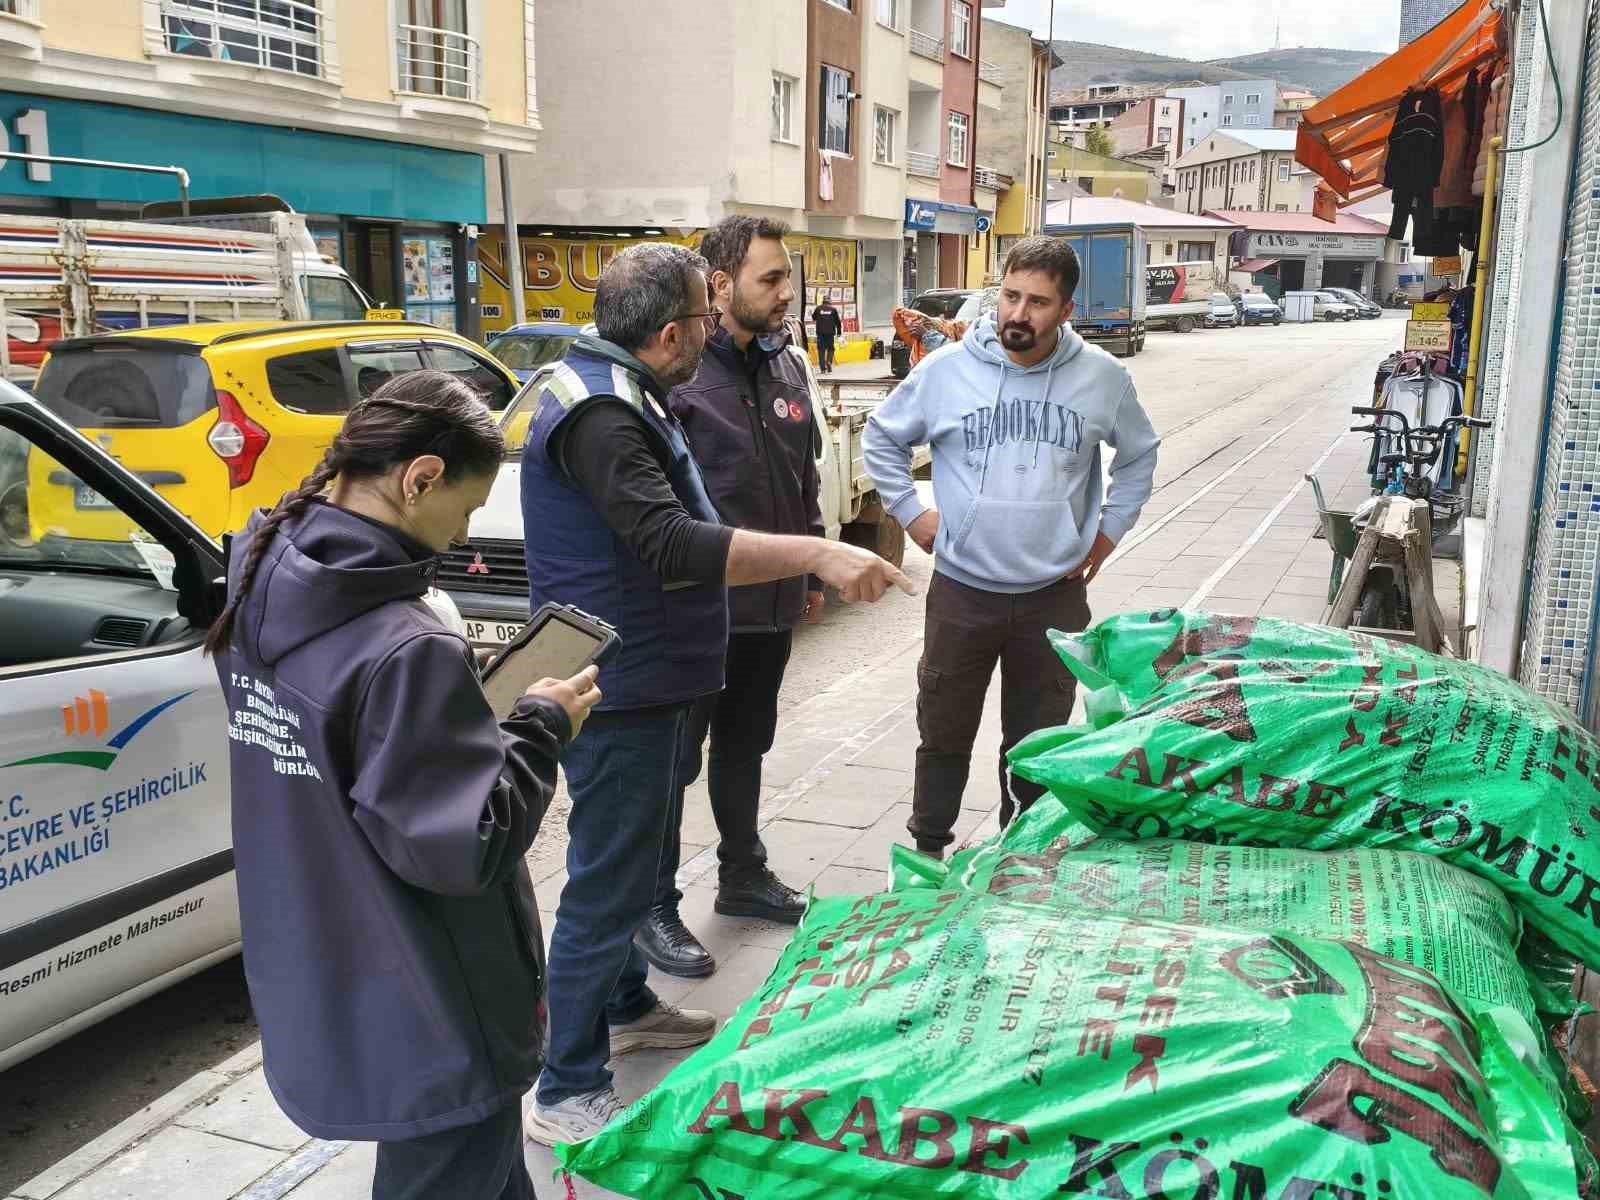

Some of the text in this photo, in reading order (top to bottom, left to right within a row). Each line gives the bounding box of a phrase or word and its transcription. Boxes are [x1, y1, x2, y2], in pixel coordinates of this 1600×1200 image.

[0, 109, 52, 182] 1
[483, 307, 500, 317] 100
[542, 309, 560, 320] 500
[1418, 337, 1439, 347] 149
[962, 399, 1085, 454] BROOKLYN
[466, 623, 485, 640] AP
[231, 672, 253, 690] T.C.
[1494, 718, 1520, 772] TRABZON
[68, 801, 95, 829] VE
[101, 762, 208, 823] ŞEHİRCİLİK
[1105, 746, 1348, 820] AKABE
[0, 794, 30, 823] .C.
[0, 826, 110, 891] BAKANLIĞI
[0, 895, 205, 996] Resmi Hizmete Mahsustur
[933, 998, 952, 1019] 62
[963, 1005, 979, 1024] 99
[687, 1081, 1032, 1181] AKABE
